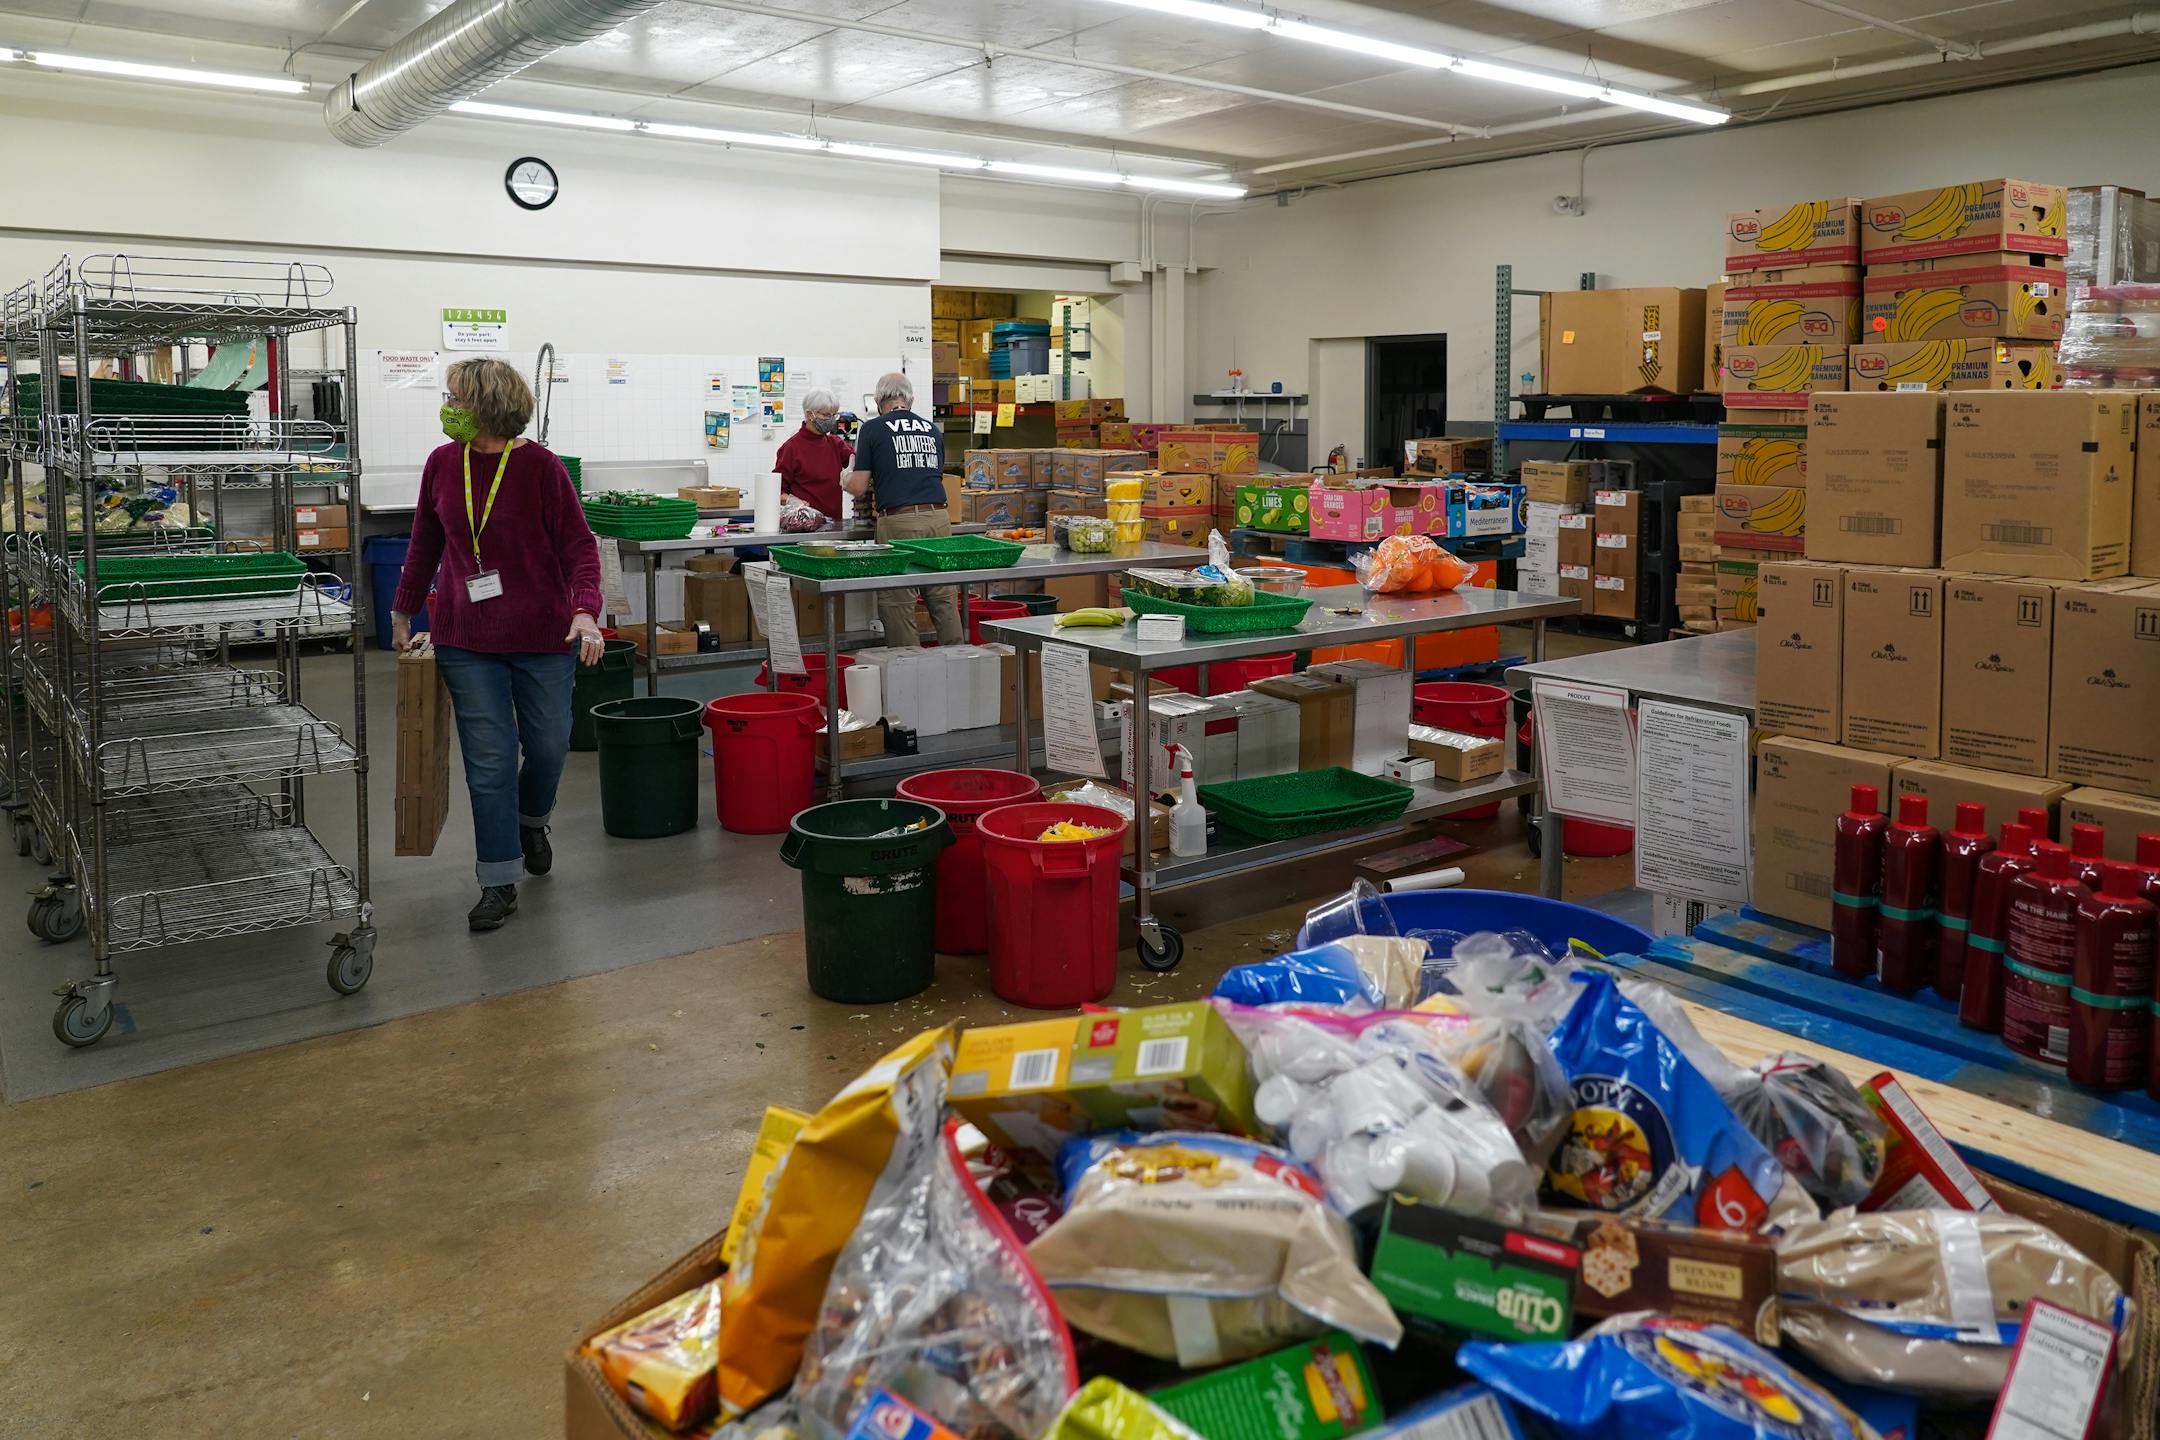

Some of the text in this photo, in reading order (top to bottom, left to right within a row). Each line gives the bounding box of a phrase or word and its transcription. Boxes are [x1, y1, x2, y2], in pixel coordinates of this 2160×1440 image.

[2012, 188, 2028, 199] Dole
[1965, 201, 2000, 213] PREMIUM
[1876, 212, 1901, 224] Dole
[1965, 210, 2001, 222] BANANAS
[1736, 221, 1758, 233] Dole
[1813, 220, 1845, 229] PREMIUM
[1813, 228, 1845, 237] BANANAS
[1866, 303, 1897, 313] BANANAS
[456, 310, 462, 319] 2
[466, 310, 473, 319] 3
[477, 310, 482, 319] 4
[486, 310, 492, 320] 5
[496, 311, 501, 320] 6
[1964, 310, 1992, 322] Dole
[1805, 321, 1828, 332] Dole
[1733, 359, 1756, 369] Dole
[1811, 364, 1843, 372] PREMIUM
[1860, 358, 1885, 369] Dole
[1951, 361, 1989, 371] PREMIUM
[1810, 372, 1842, 380] BANANAS
[1951, 370, 1989, 380] BANANAS
[1814, 403, 1819, 413] 4
[1953, 402, 1958, 413] 4
[2146, 403, 2152, 413] 4
[886, 418, 933, 433] VEAP
[892, 435, 937, 454] VOLUNTEERS
[896, 453, 913, 469] LIGHT
[913, 453, 926, 468] THE
[1262, 496, 1283, 509] LIMES
[1334, 494, 1344, 502] CARA
[1725, 498, 1748, 508] Dole
[1323, 501, 1344, 509] ORANGES
[1470, 516, 1509, 526] Mediterranean
[1763, 575, 1768, 584] 4
[1852, 582, 1857, 592] 4
[1954, 590, 1959, 600] 4
[2064, 601, 2070, 611] 4
[1780, 639, 1813, 650] Old Spice
[1871, 651, 1908, 662] Old Spice
[1975, 661, 2015, 673] Old Spice
[2087, 676, 2131, 689] Old Spice
[1567, 692, 1591, 701] PRODUCE
[1650, 708, 1676, 718] Guidelines
[1685, 714, 1716, 726] Refrigerated
[1716, 720, 1731, 728] Foods
[871, 845, 918, 861] BRUTE
[1643, 850, 1669, 861] Guidelines
[1678, 859, 1723, 873] Non-Refrigerated
[1723, 868, 1740, 876] Foods
[2015, 900, 2028, 912] FOR
[2029, 905, 2045, 917] THE
[2123, 932, 2139, 941] FOR
[1495, 1287, 1564, 1333] CLUB
[2036, 1307, 2109, 1343] Nutrition Facts
